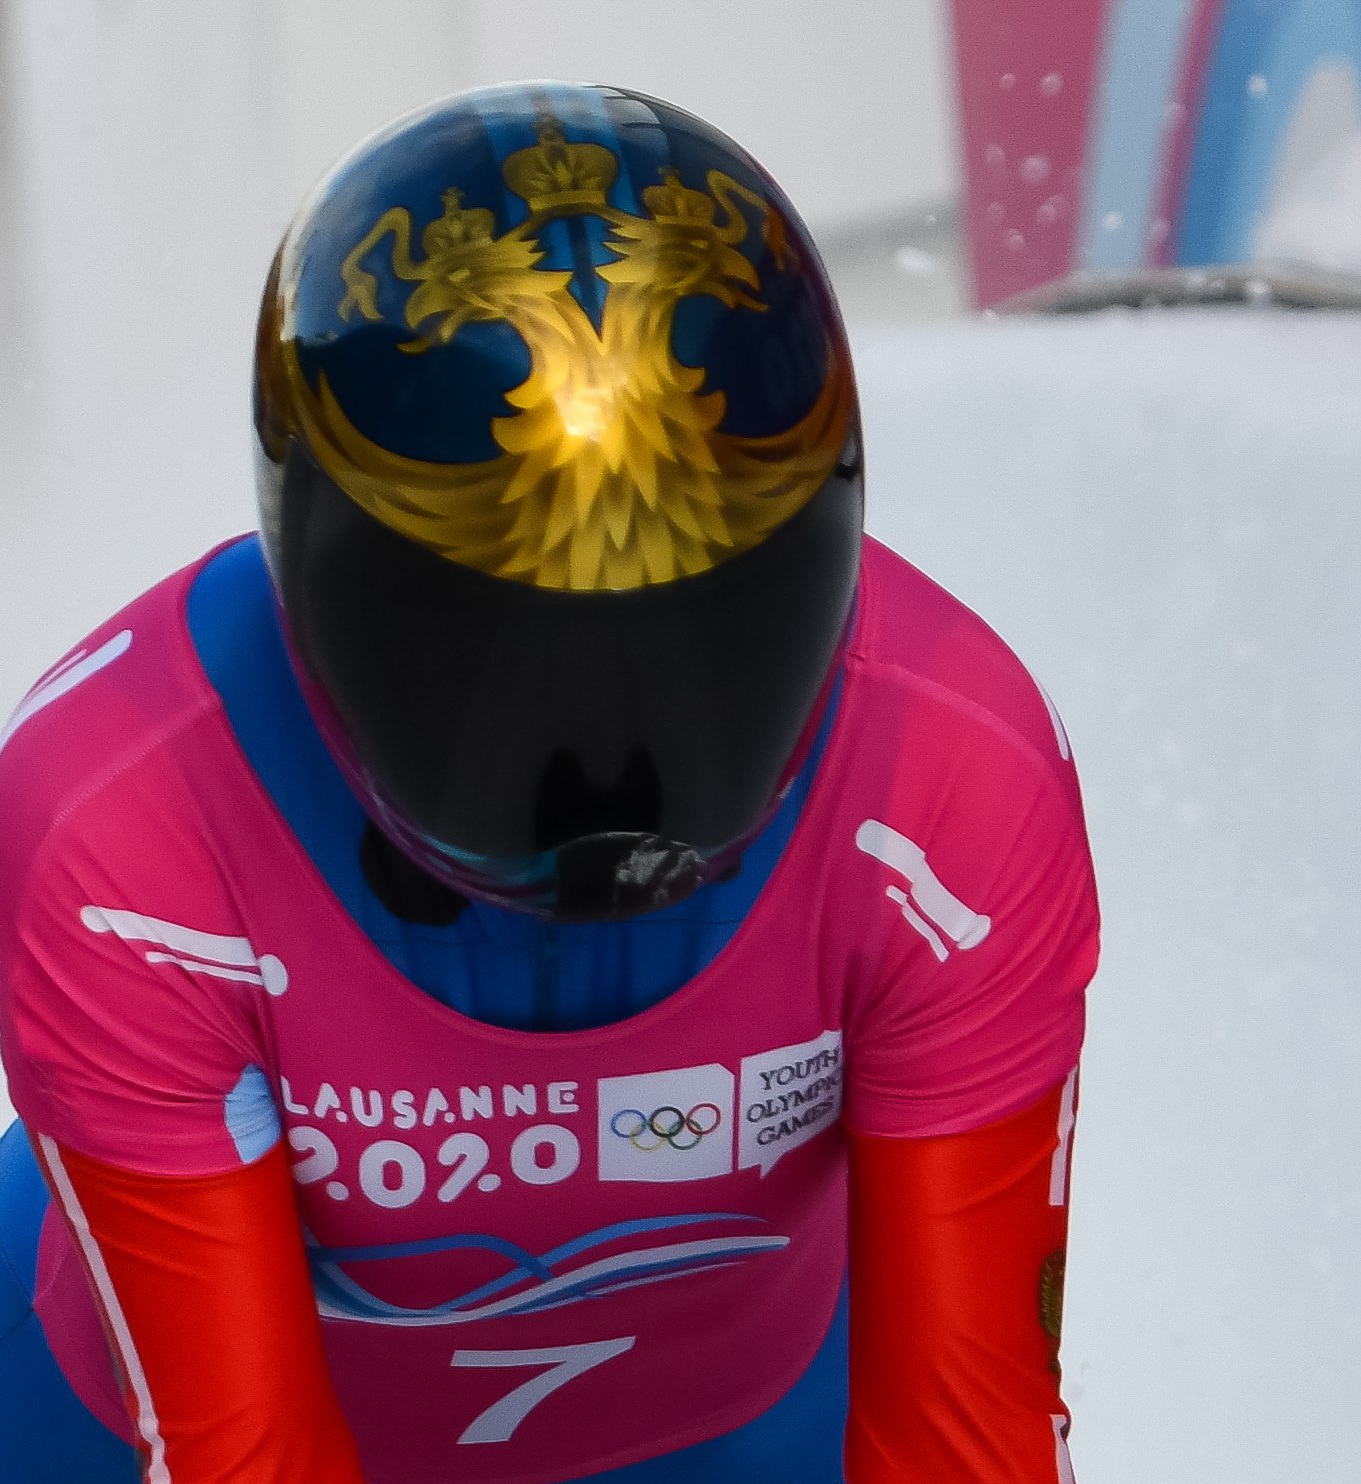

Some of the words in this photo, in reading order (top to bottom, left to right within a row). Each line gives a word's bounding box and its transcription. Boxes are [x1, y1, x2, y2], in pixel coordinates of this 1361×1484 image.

[759, 1046, 840, 1091] YOUTH
[280, 1075, 580, 1130] LAUSANNE
[757, 1097, 834, 1146] GAMES
[288, 1125, 581, 1209] 2020
[450, 1335, 637, 1445] 7
